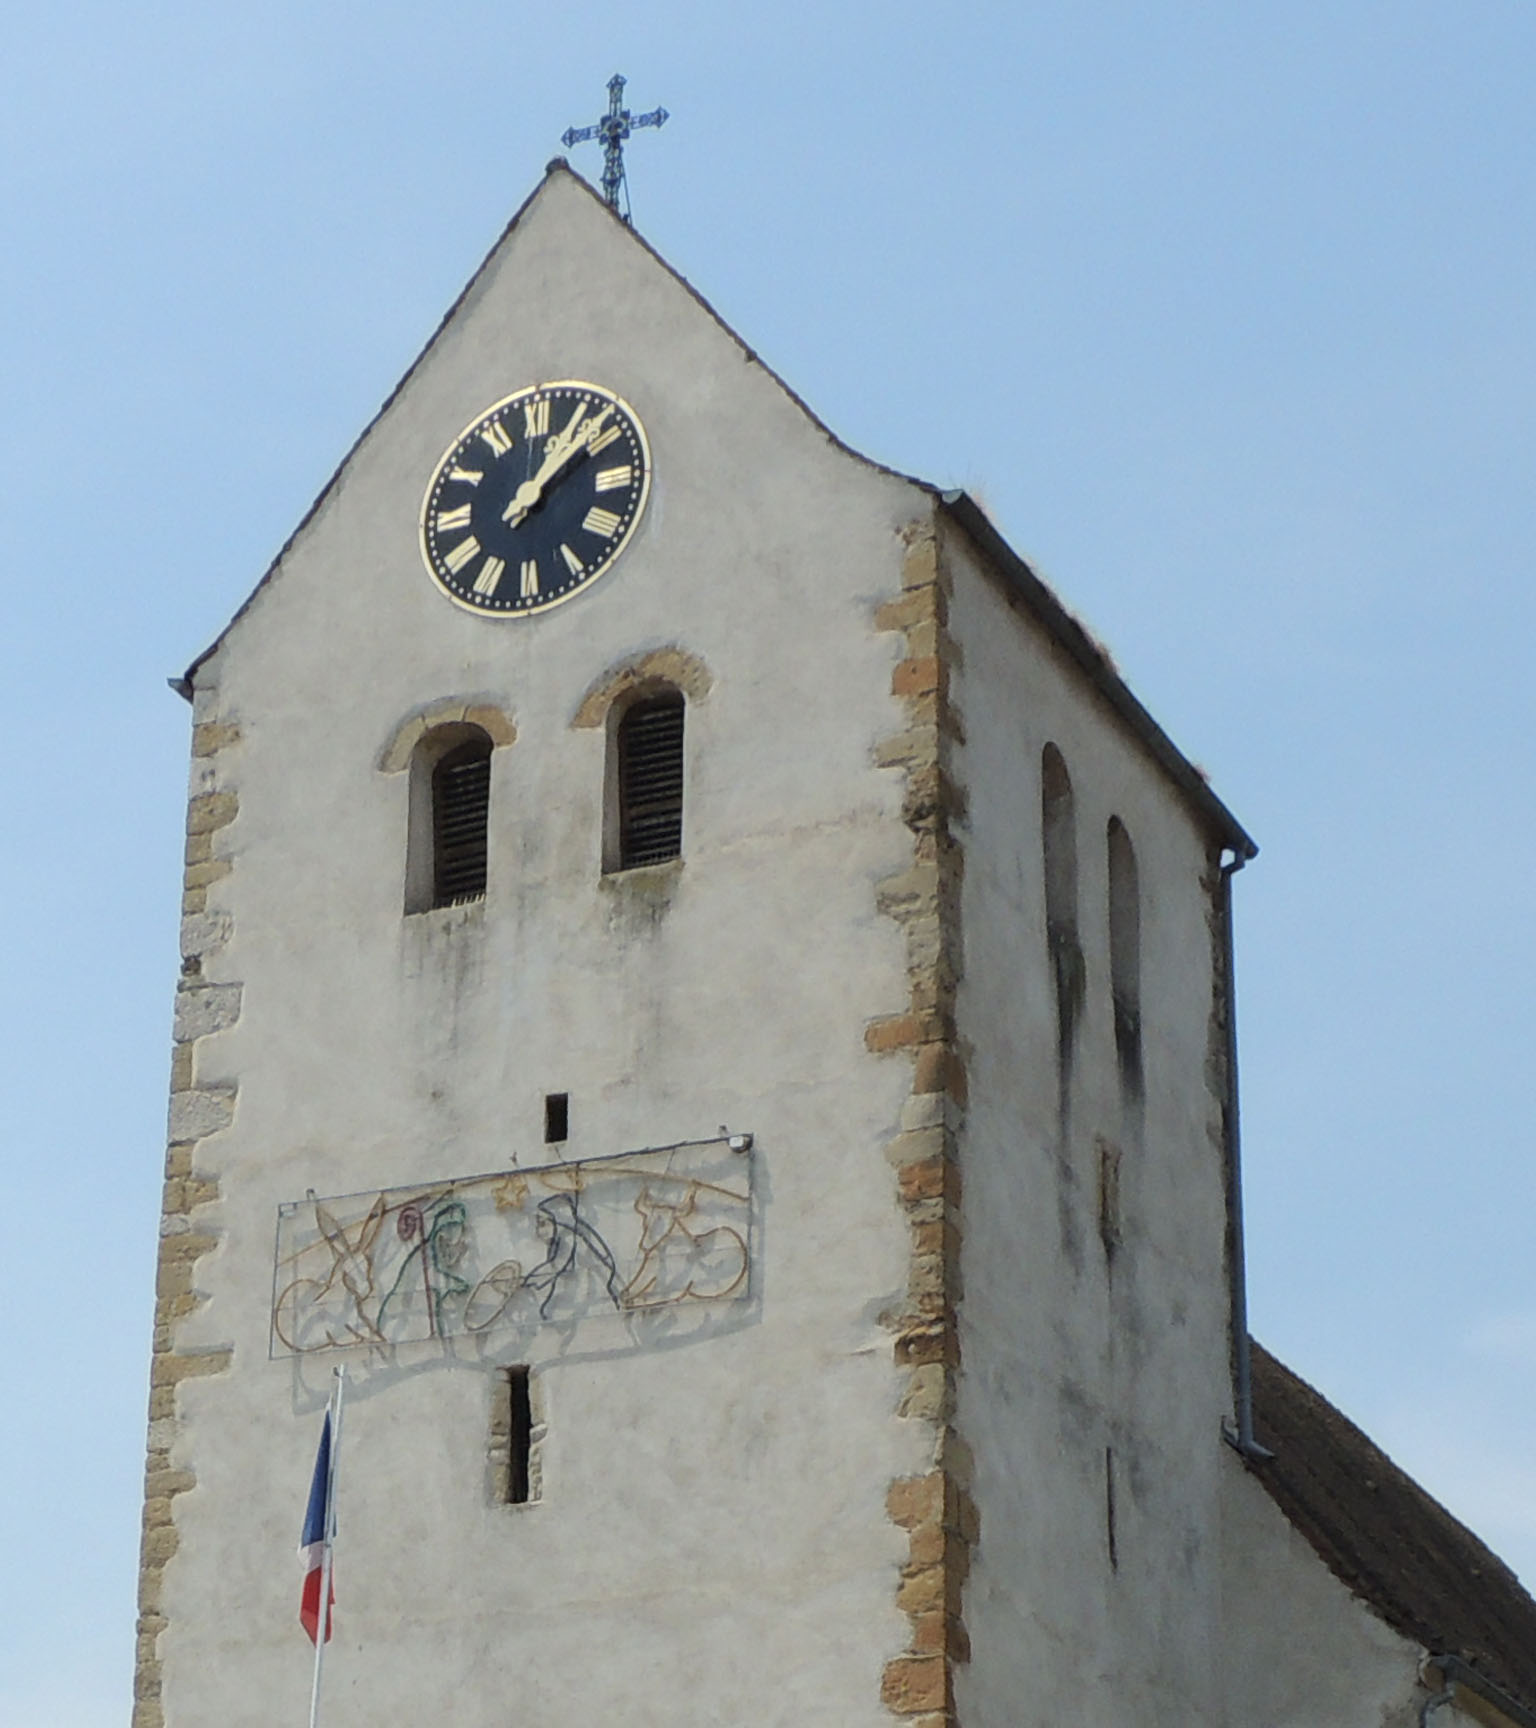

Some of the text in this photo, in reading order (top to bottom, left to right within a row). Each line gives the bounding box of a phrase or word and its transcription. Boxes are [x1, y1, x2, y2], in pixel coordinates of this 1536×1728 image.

[524, 400, 550, 439] XII
[481, 421, 513, 458] XI
[587, 425, 622, 457] II
[449, 465, 484, 487] X
[595, 465, 631, 492] III
[437, 503, 471, 533] IX
[443, 535, 481, 574] VIII
[560, 543, 584, 575] V
[473, 556, 505, 597] VII
[520, 559, 539, 598] VI
